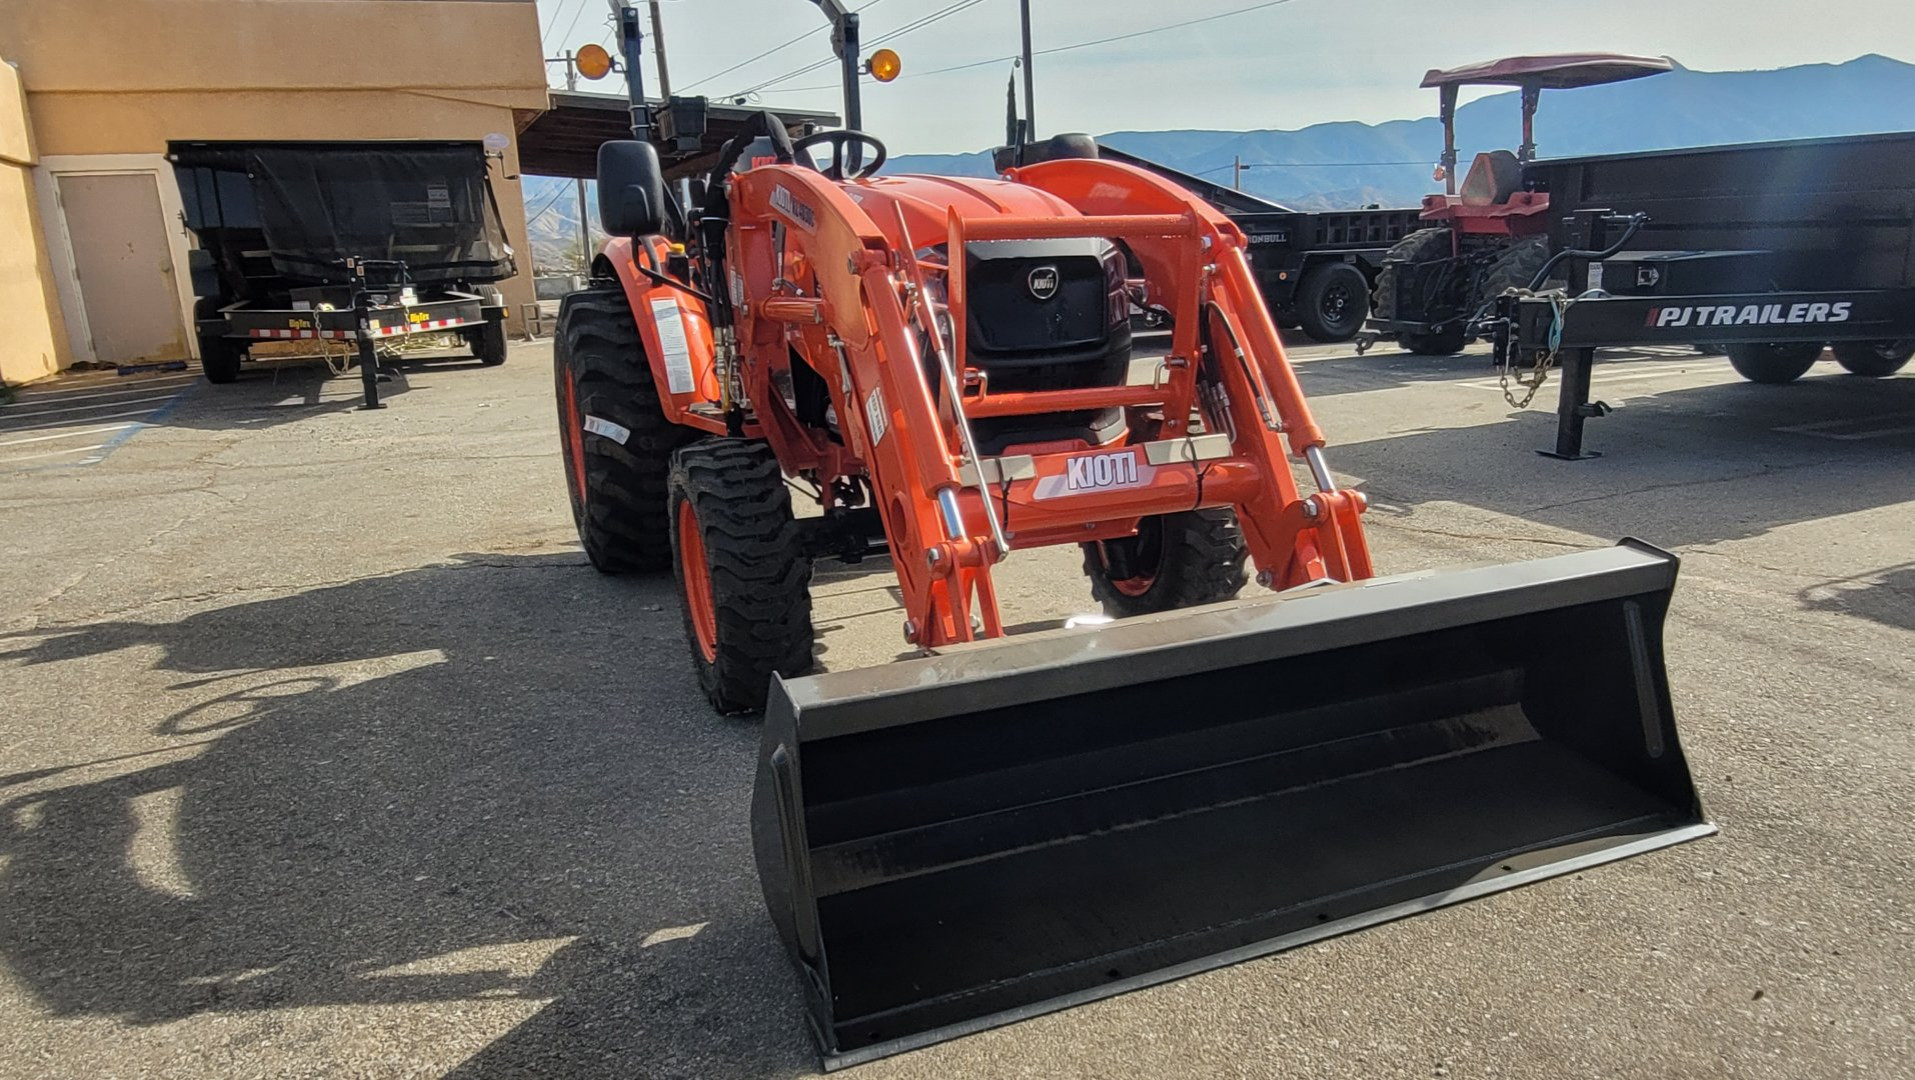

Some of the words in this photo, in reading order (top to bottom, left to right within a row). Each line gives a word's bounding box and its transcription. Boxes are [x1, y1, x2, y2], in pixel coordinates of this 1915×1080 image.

[1656, 307, 1692, 327] PJ
[1696, 302, 1852, 326] TRAILERS
[1067, 451, 1138, 490] KIOTI
